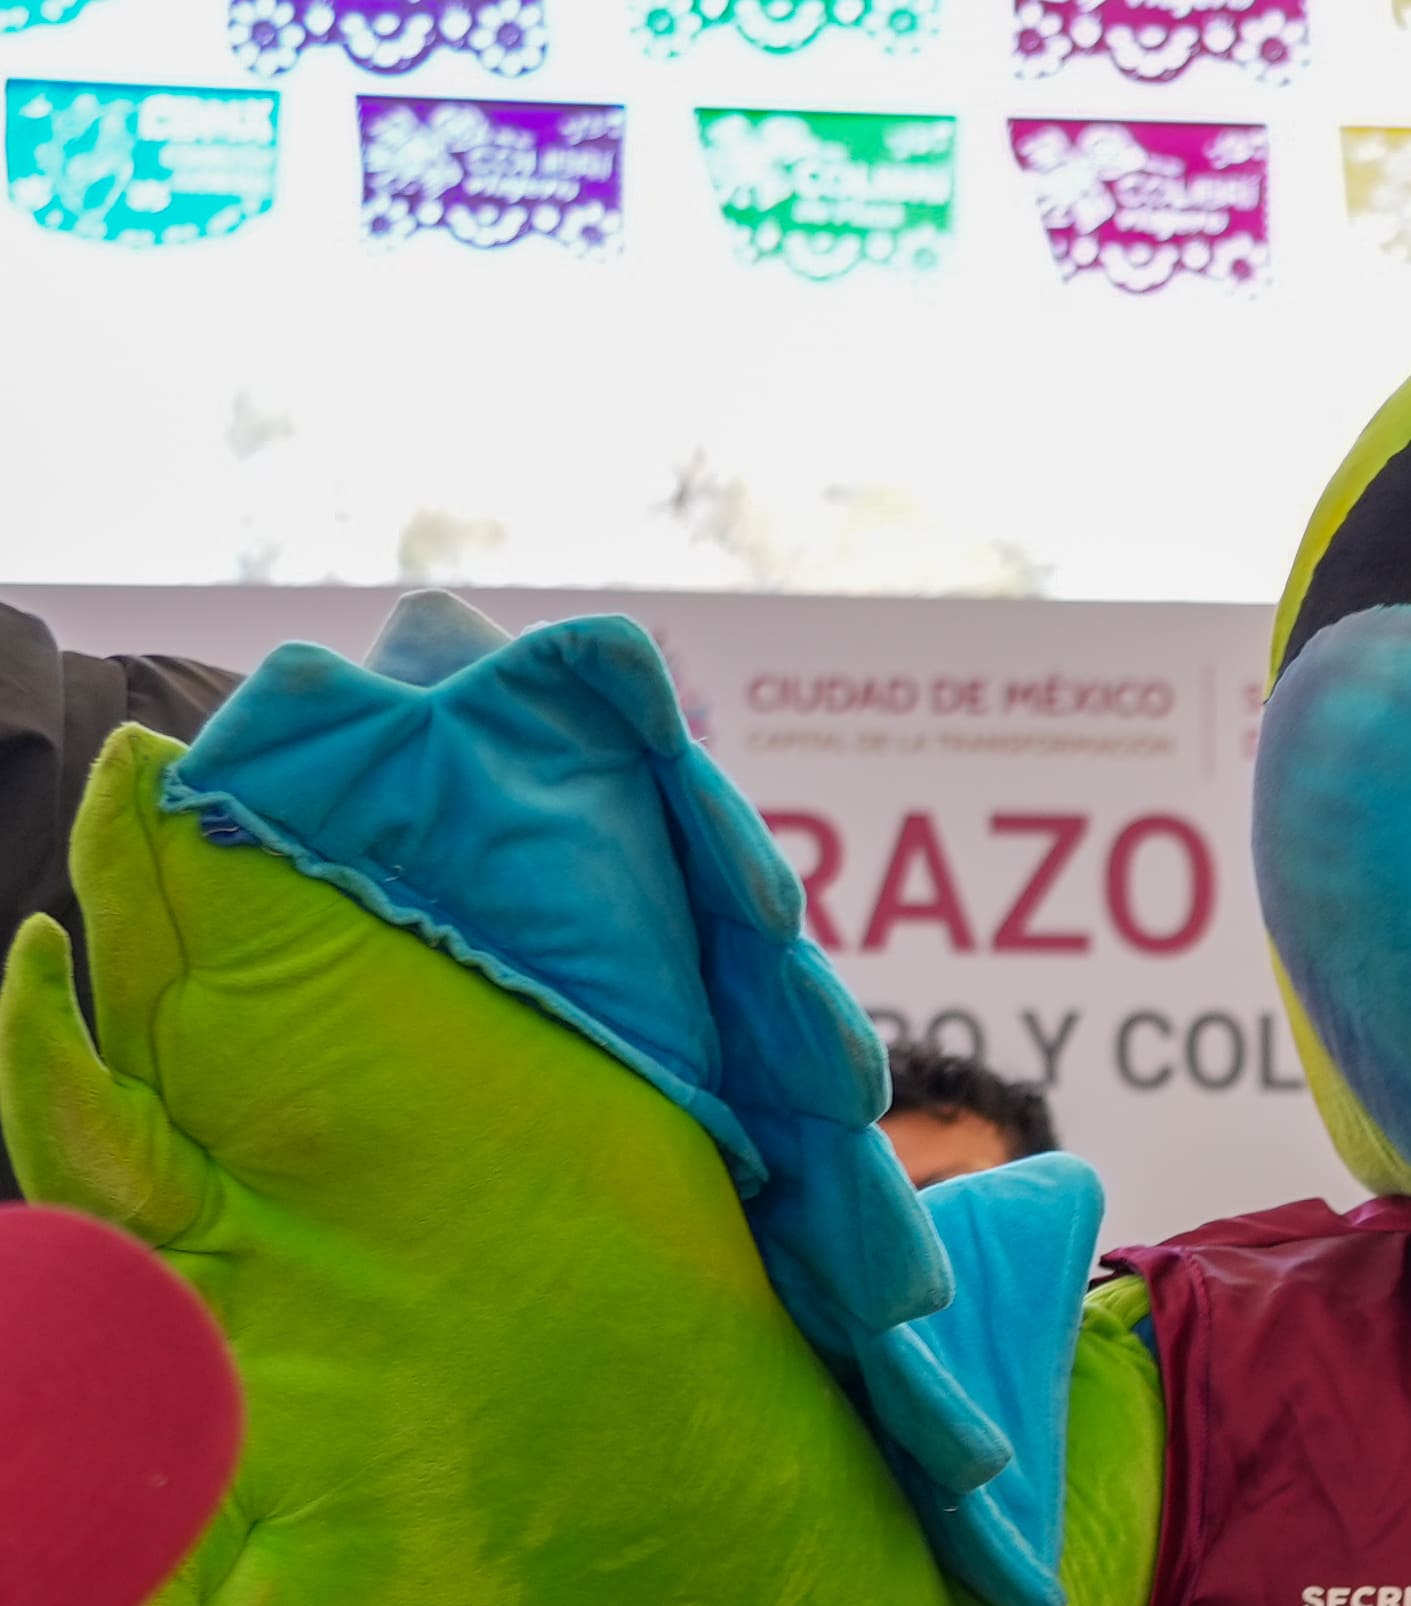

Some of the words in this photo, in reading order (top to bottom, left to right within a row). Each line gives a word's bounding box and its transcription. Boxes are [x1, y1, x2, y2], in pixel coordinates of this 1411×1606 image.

[747, 674, 919, 716] CIUDAD
[931, 675, 986, 716] DE
[1003, 671, 1175, 719] MÉXICO
[1021, 1006, 1081, 1089] Y
